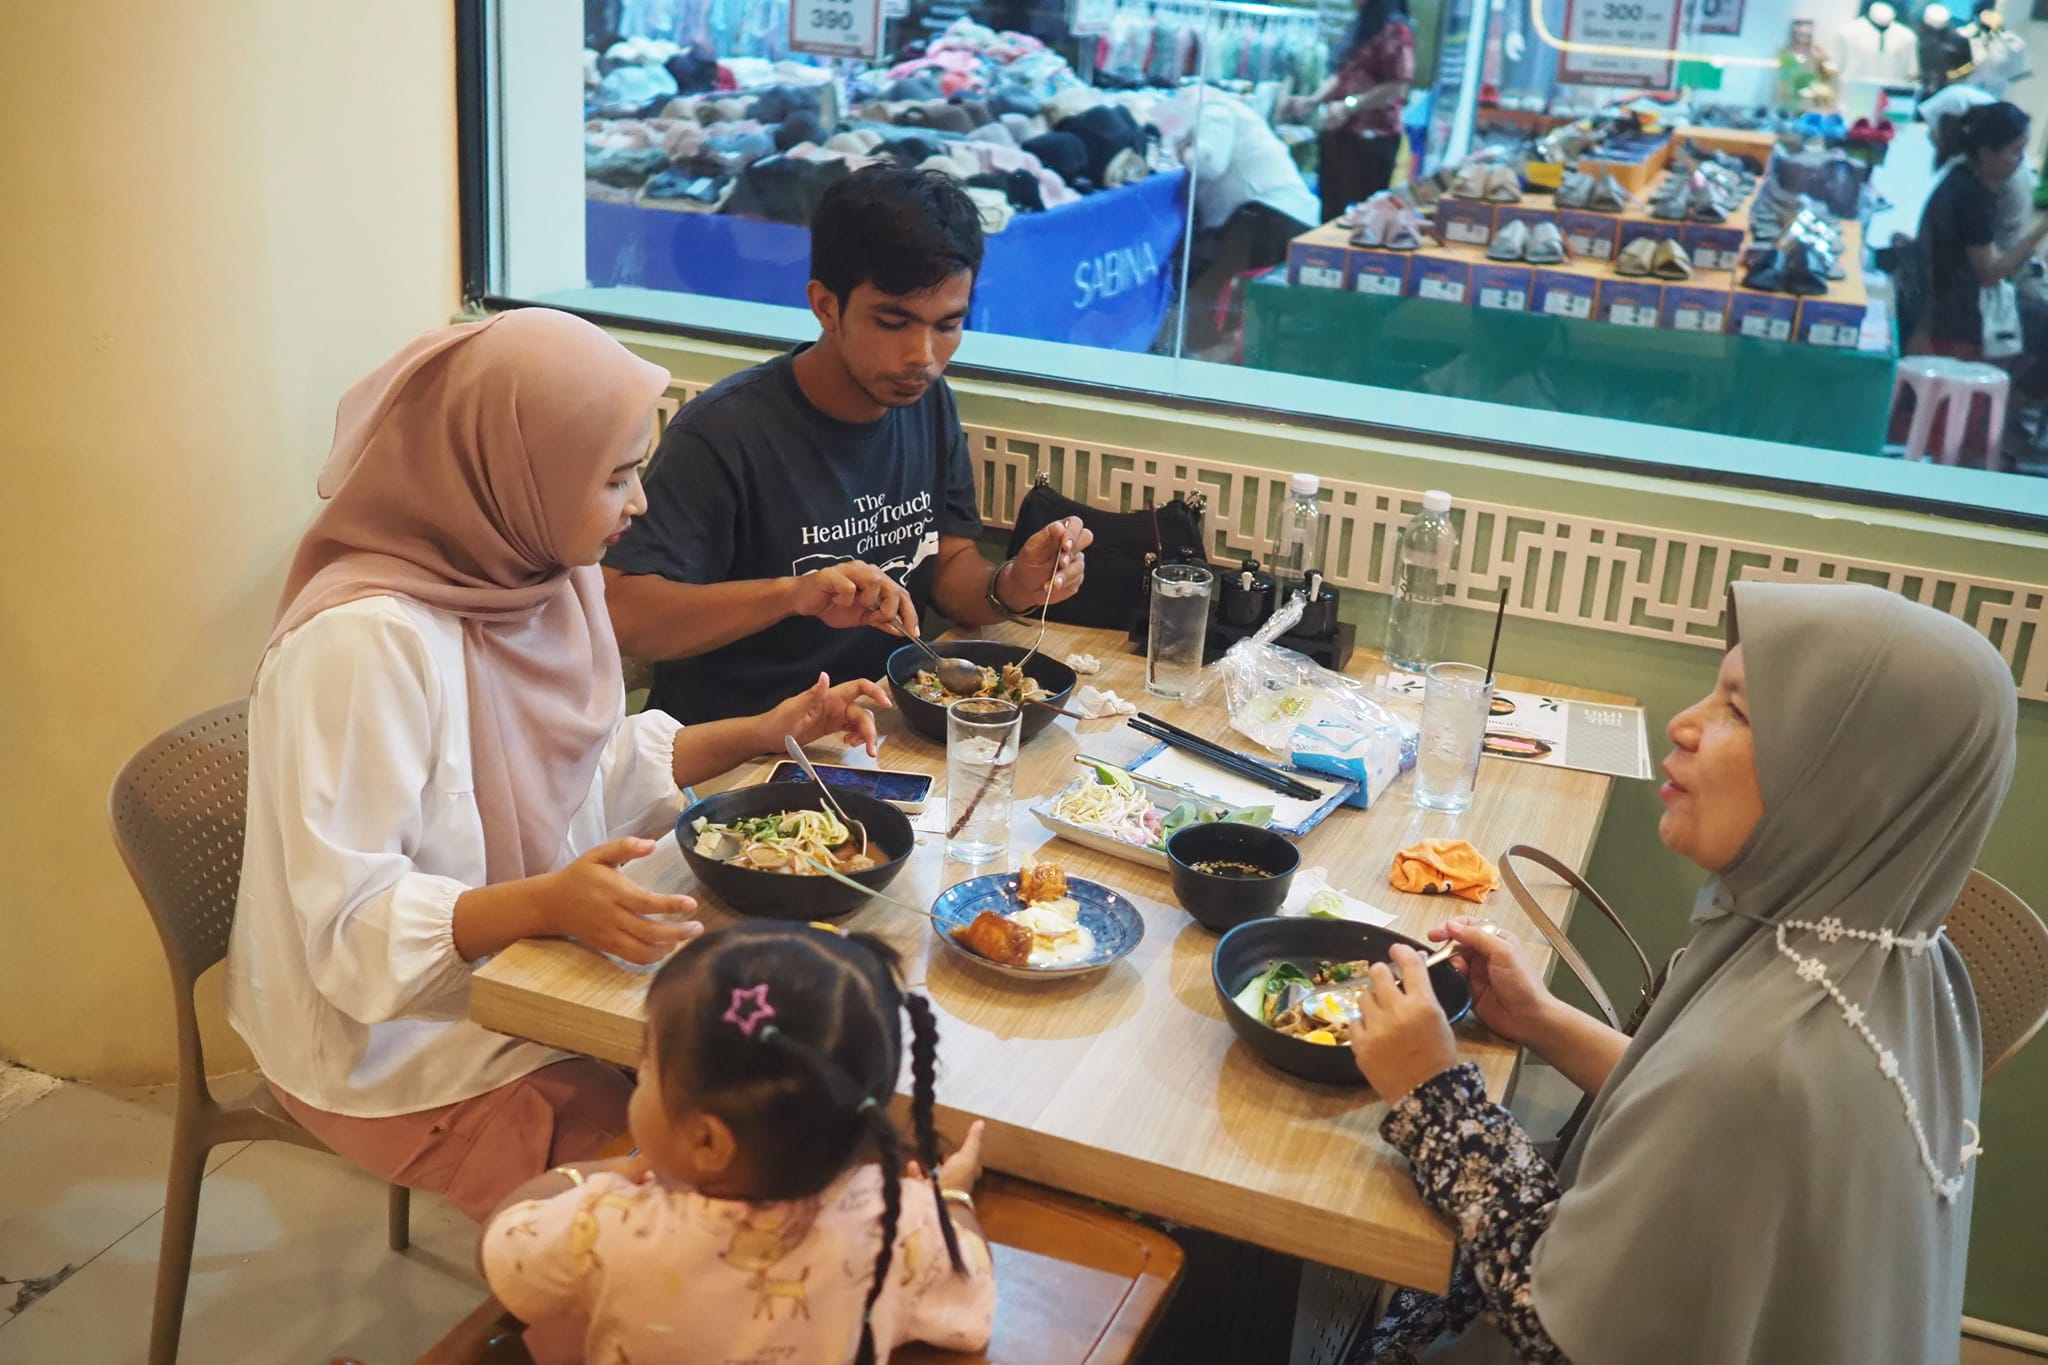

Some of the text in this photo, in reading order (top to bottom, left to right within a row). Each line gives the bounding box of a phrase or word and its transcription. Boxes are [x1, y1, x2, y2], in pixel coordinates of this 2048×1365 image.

[810, 8, 854, 31] 390
[1073, 241, 1159, 309] SABINA
[801, 490, 931, 545] Healing Touch
[853, 492, 886, 513] The
